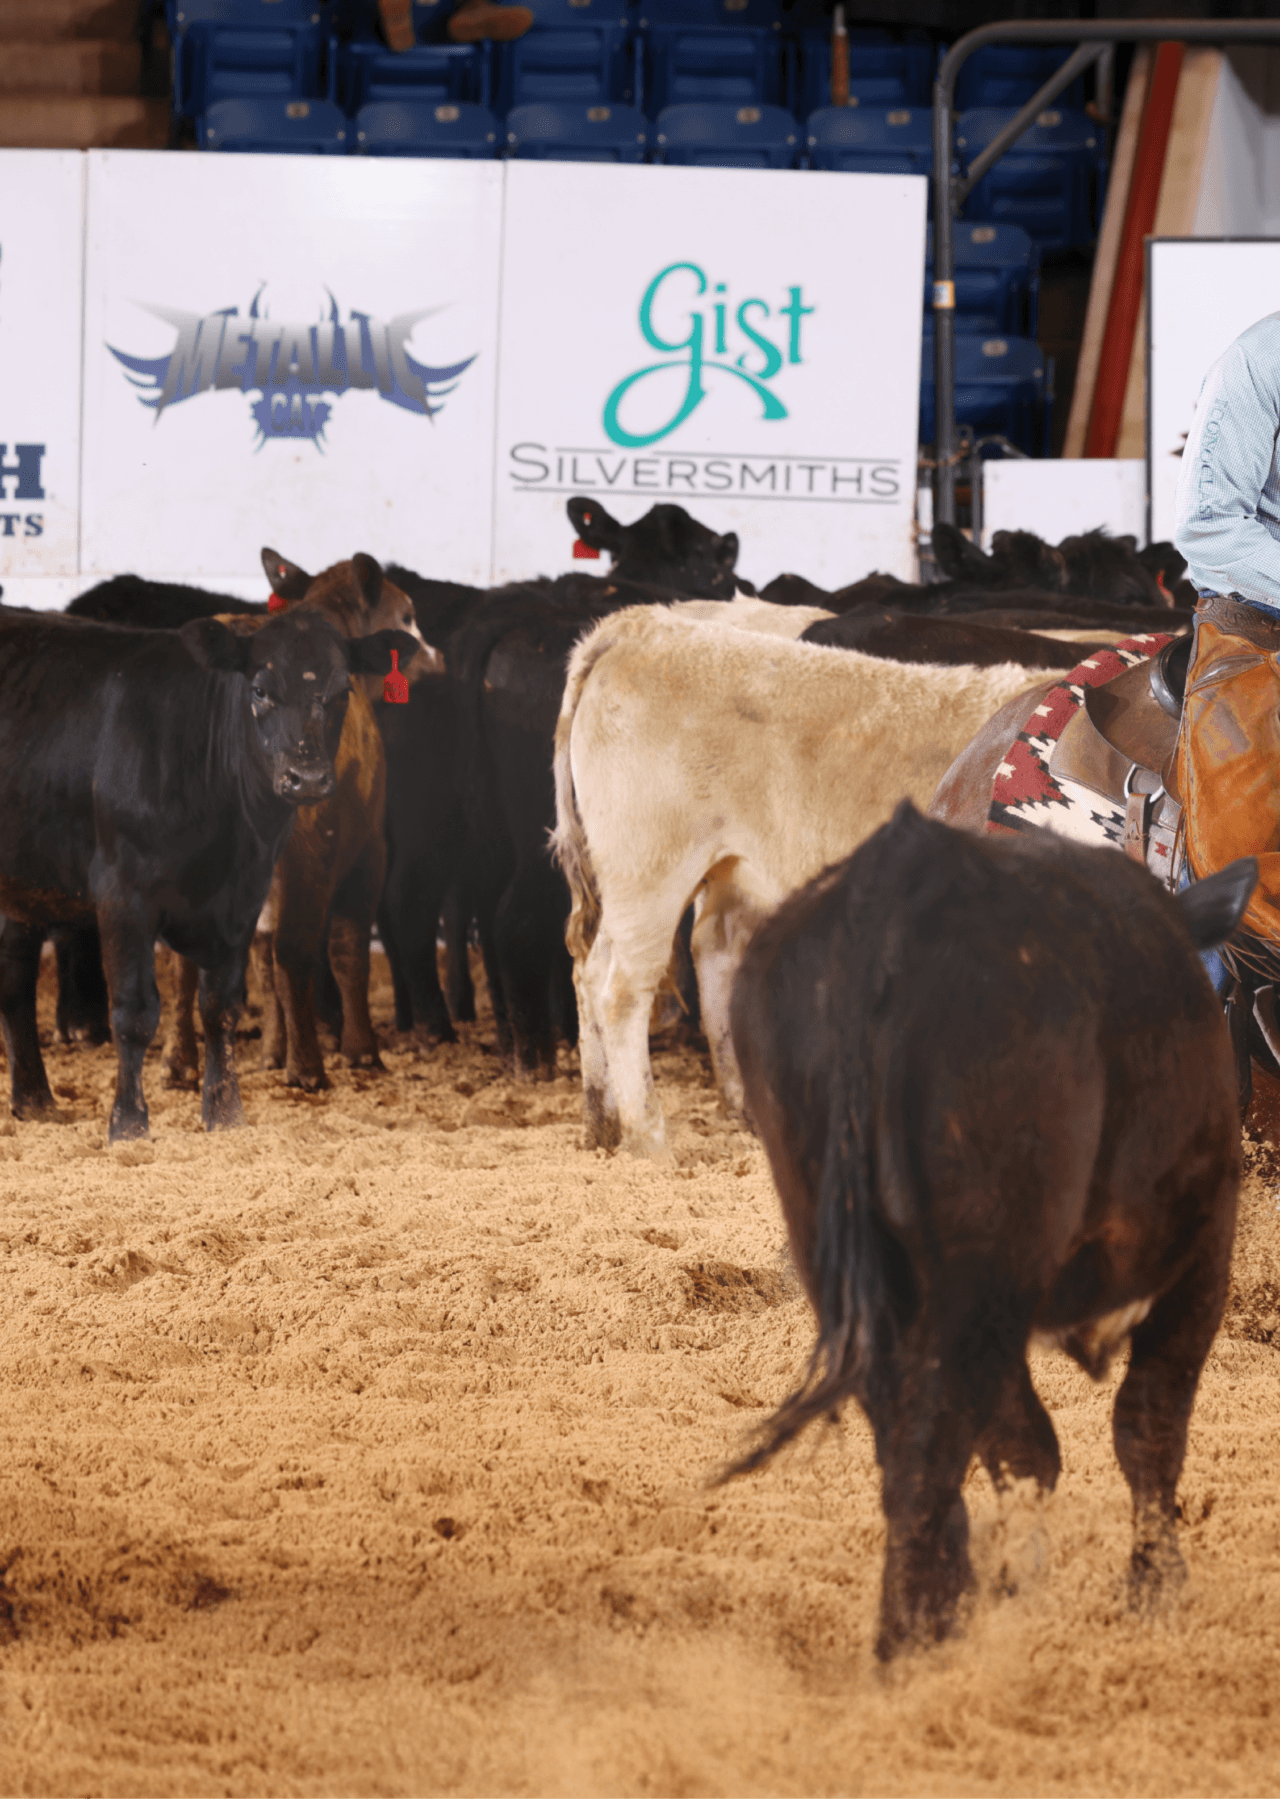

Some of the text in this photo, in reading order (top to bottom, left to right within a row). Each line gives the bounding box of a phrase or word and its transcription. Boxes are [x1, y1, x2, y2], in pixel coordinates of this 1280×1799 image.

[153, 310, 436, 424] METALLIC
[603, 261, 815, 449] Gist
[271, 393, 331, 433] CAT
[509, 442, 900, 497] SILVERSMITHS
